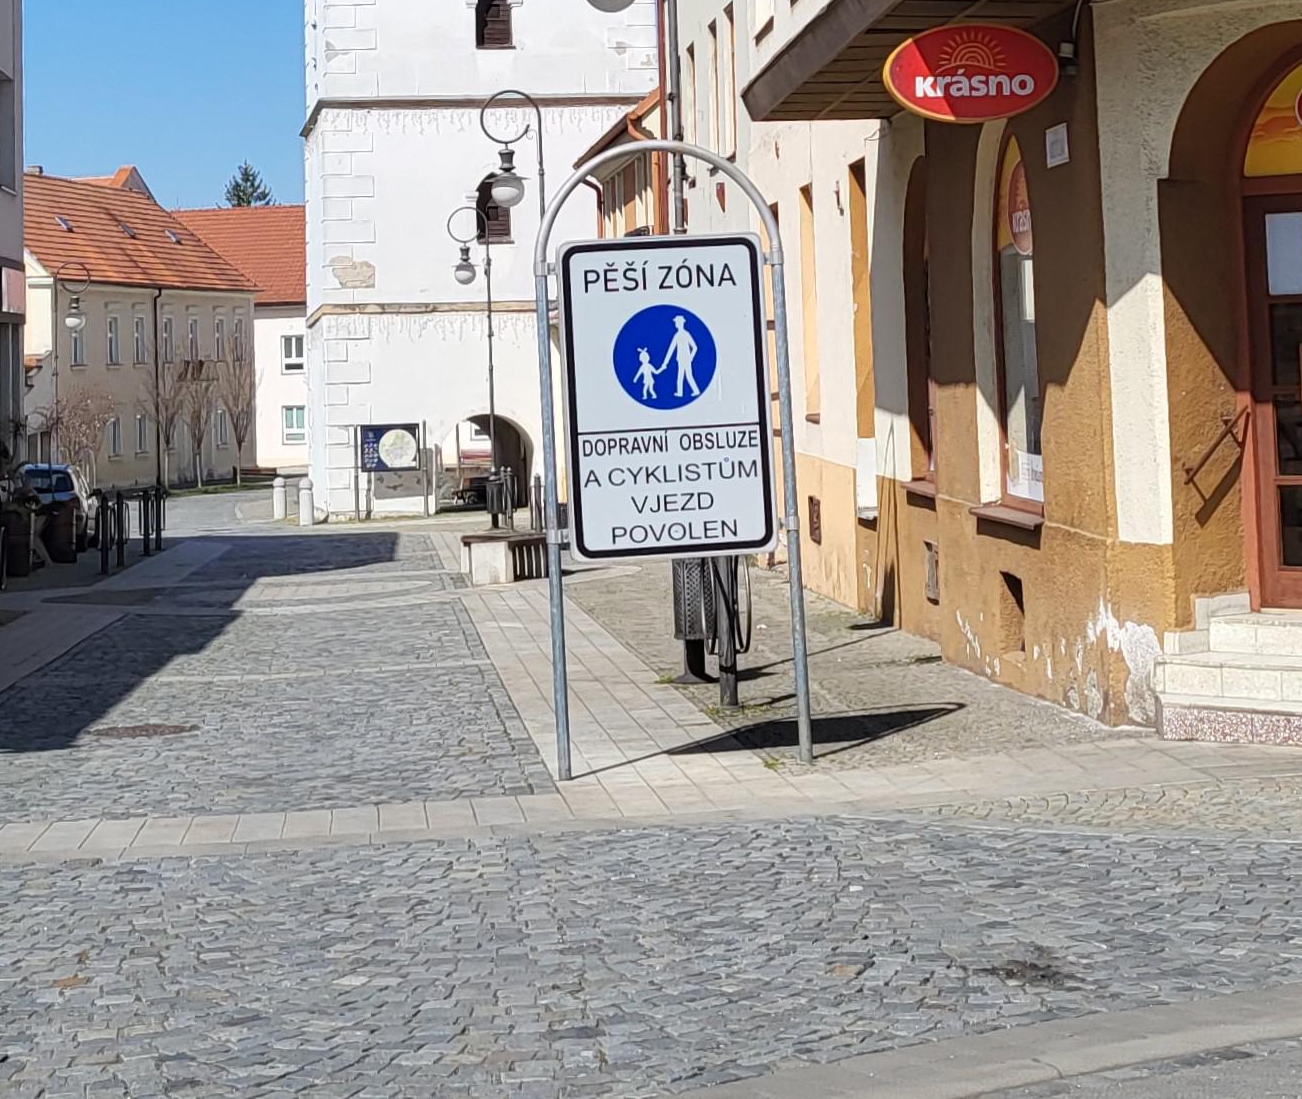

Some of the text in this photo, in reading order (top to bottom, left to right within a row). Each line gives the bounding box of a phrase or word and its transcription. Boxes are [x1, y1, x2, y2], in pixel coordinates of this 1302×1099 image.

[915, 68, 1035, 98] Krásno
[583, 258, 737, 293] PĚŠÍ ZÓNA
[582, 430, 759, 458] DOPRAVNÍ OBSLUZE
[584, 457, 759, 488] A CYKLISTŮM
[631, 491, 714, 515] VJEZD
[611, 519, 738, 545] POVOLEN
